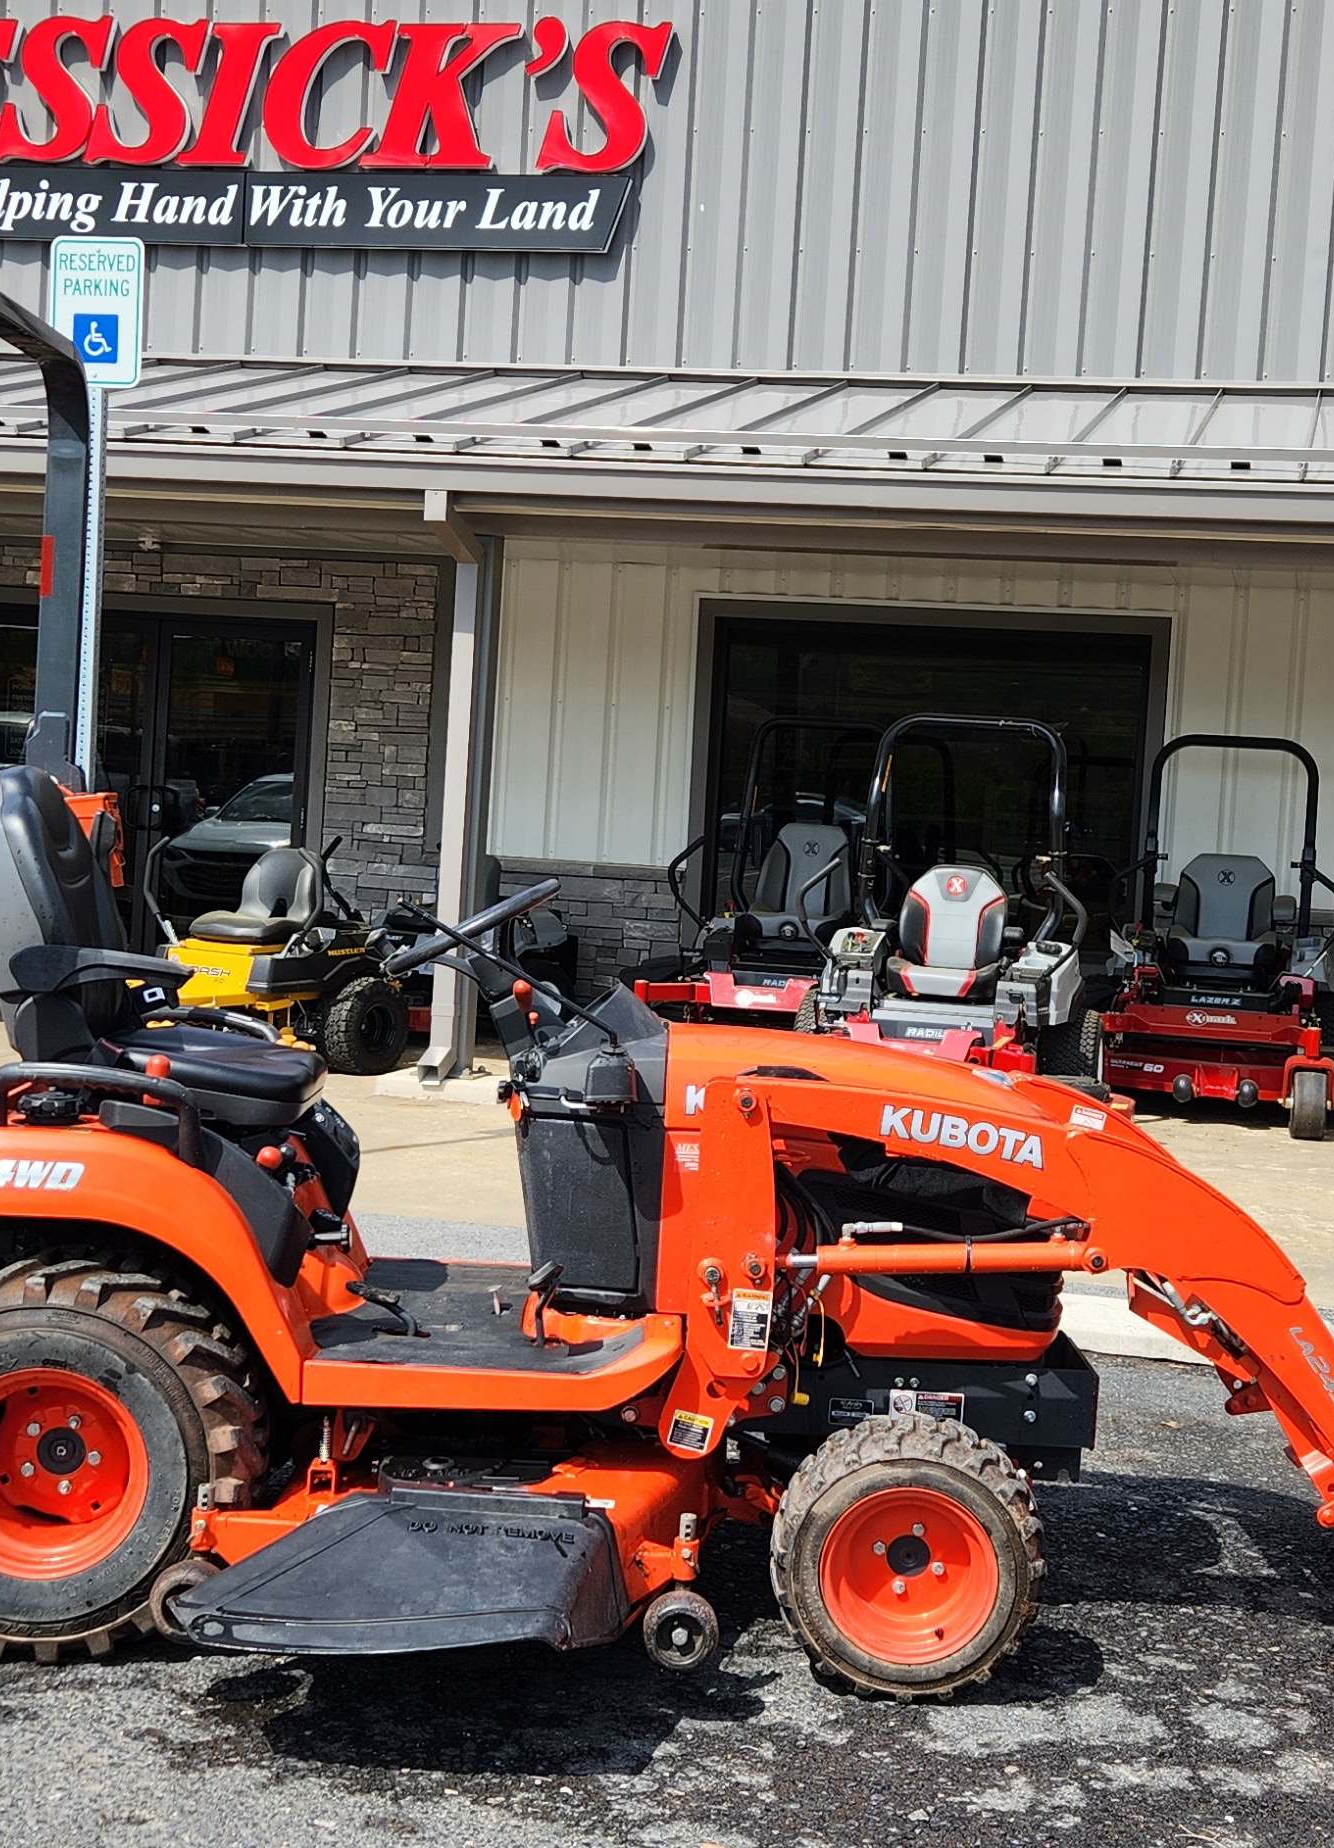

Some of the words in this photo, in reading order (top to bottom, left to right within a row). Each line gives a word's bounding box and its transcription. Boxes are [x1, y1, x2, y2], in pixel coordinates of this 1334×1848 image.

[111, 182, 234, 226] Hand
[249, 185, 347, 230] With
[364, 188, 467, 230] Your
[475, 190, 597, 233] Land
[58, 253, 136, 272] RESERVED
[63, 278, 130, 297] PARKING
[327, 948, 366, 957] HUSTLER
[762, 978, 786, 987] RAD
[905, 1026, 947, 1038] RADIU
[1143, 1063, 1165, 1073] 60
[879, 1103, 1044, 1170] KUBOTA
[407, 1520, 438, 1534] DO
[447, 1522, 489, 1536] NOT
[496, 1525, 575, 1545] REMOVE
